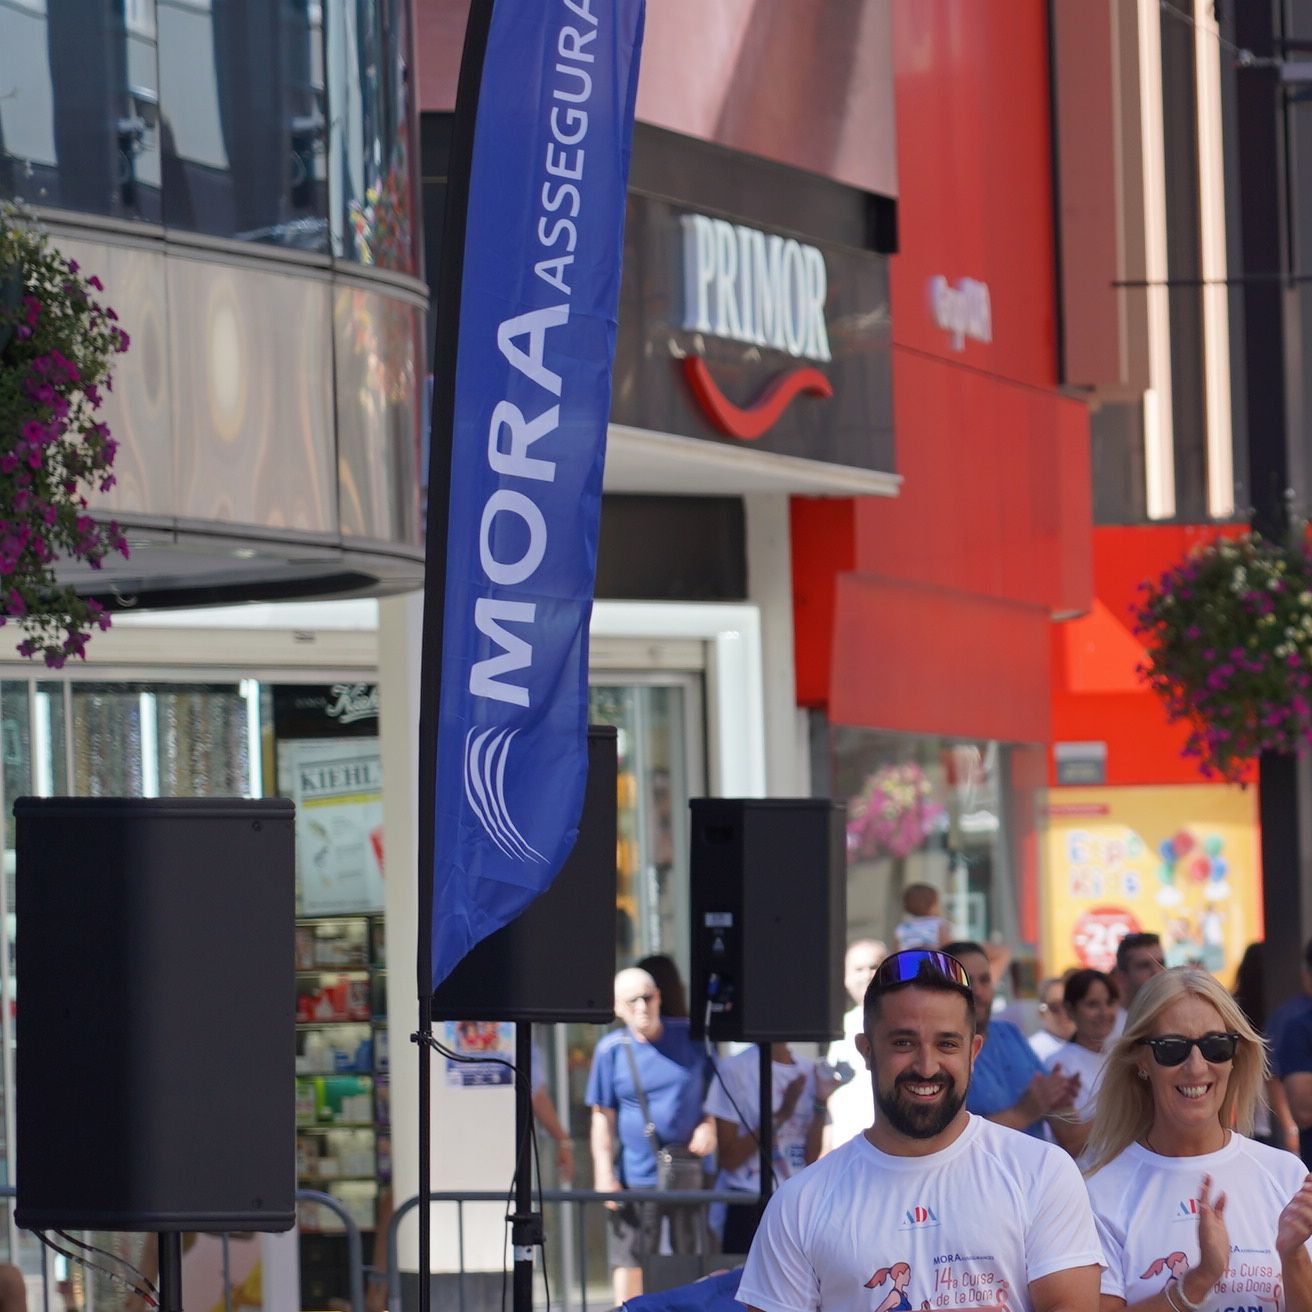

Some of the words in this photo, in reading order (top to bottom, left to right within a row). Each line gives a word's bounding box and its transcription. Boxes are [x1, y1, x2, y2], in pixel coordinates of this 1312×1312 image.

[680, 214, 832, 362] PRIMOR
[470, 303, 570, 707] MORA
[932, 1253, 962, 1266] MORA
[962, 1271, 994, 1287] Cursa
[1240, 1263, 1273, 1279] Cursa
[1214, 1280, 1227, 1294] de
[1245, 1278, 1272, 1294] Dona
[936, 1293, 950, 1307] de
[968, 1287, 993, 1303] Dona
